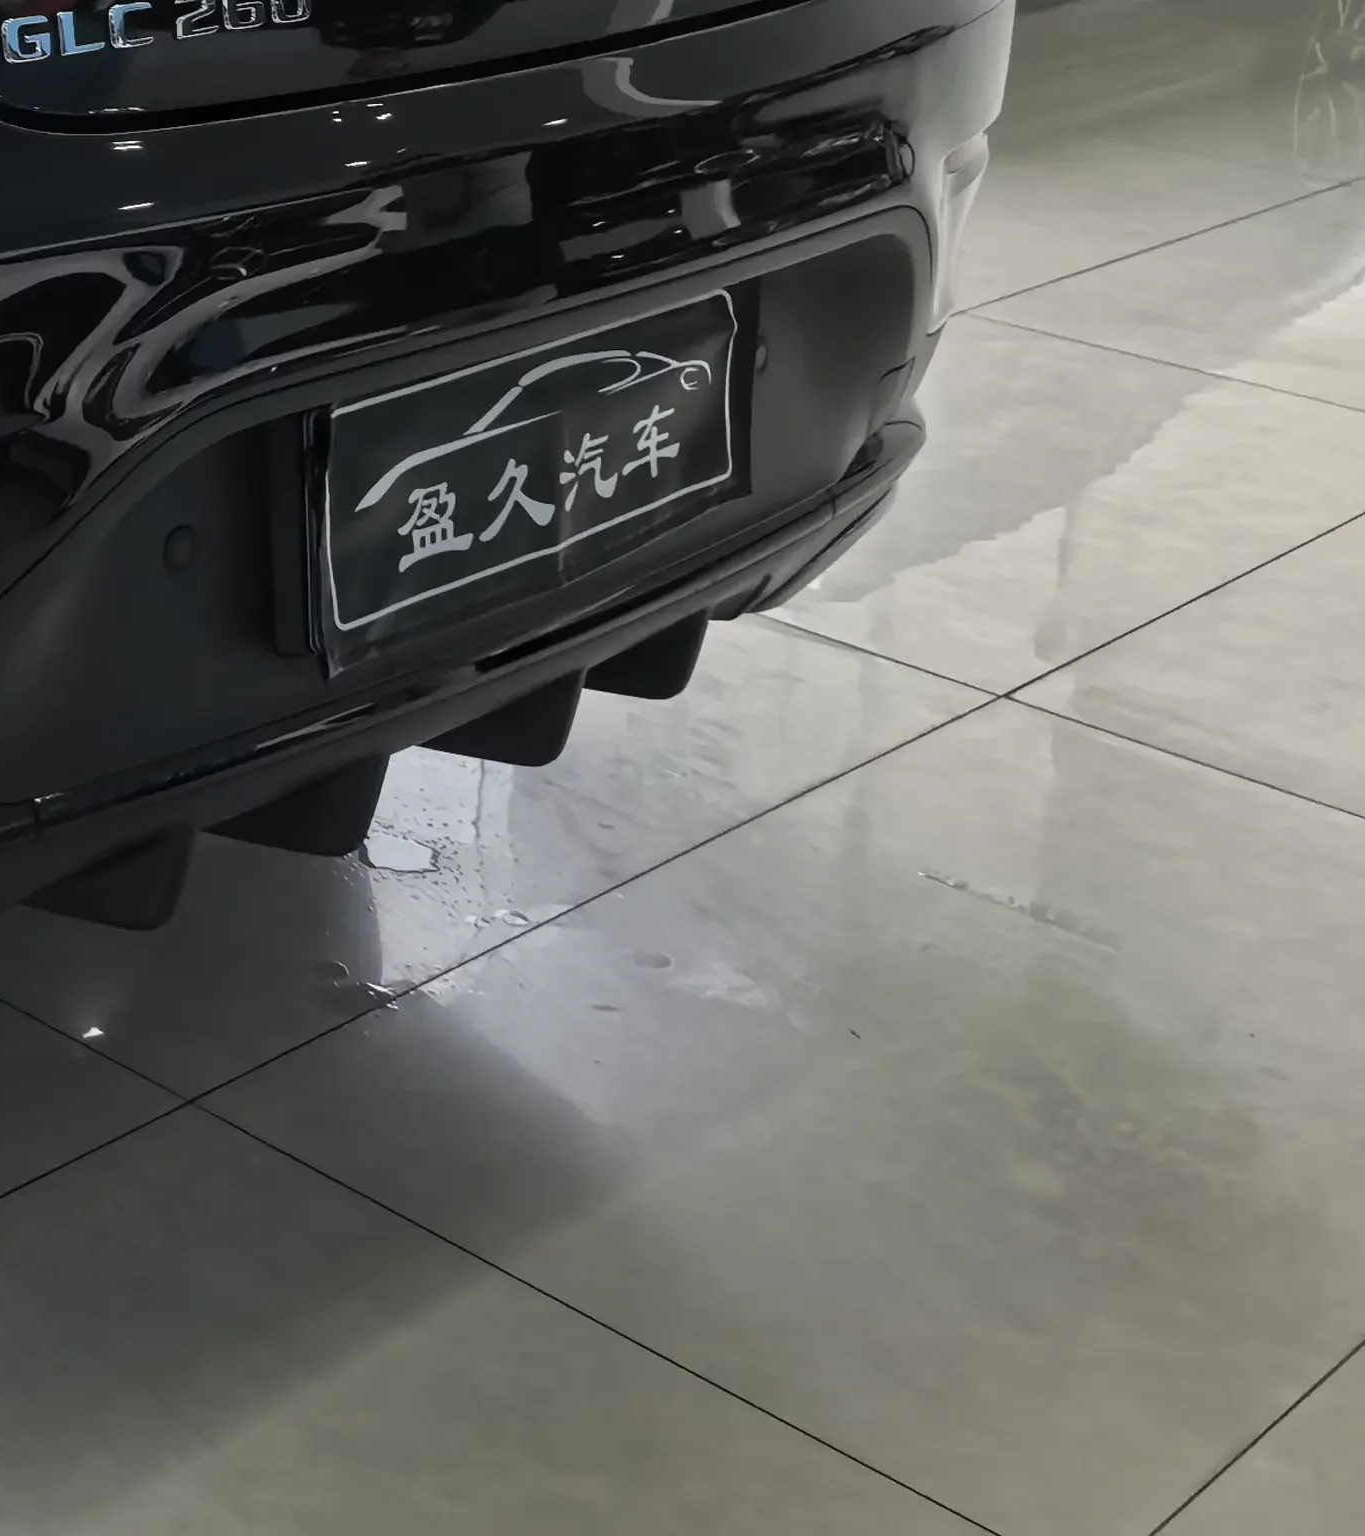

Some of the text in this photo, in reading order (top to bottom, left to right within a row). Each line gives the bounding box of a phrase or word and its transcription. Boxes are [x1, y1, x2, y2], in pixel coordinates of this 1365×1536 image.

[1, 2, 155, 65] GLC
[397, 404, 682, 573] 盈久汽车
